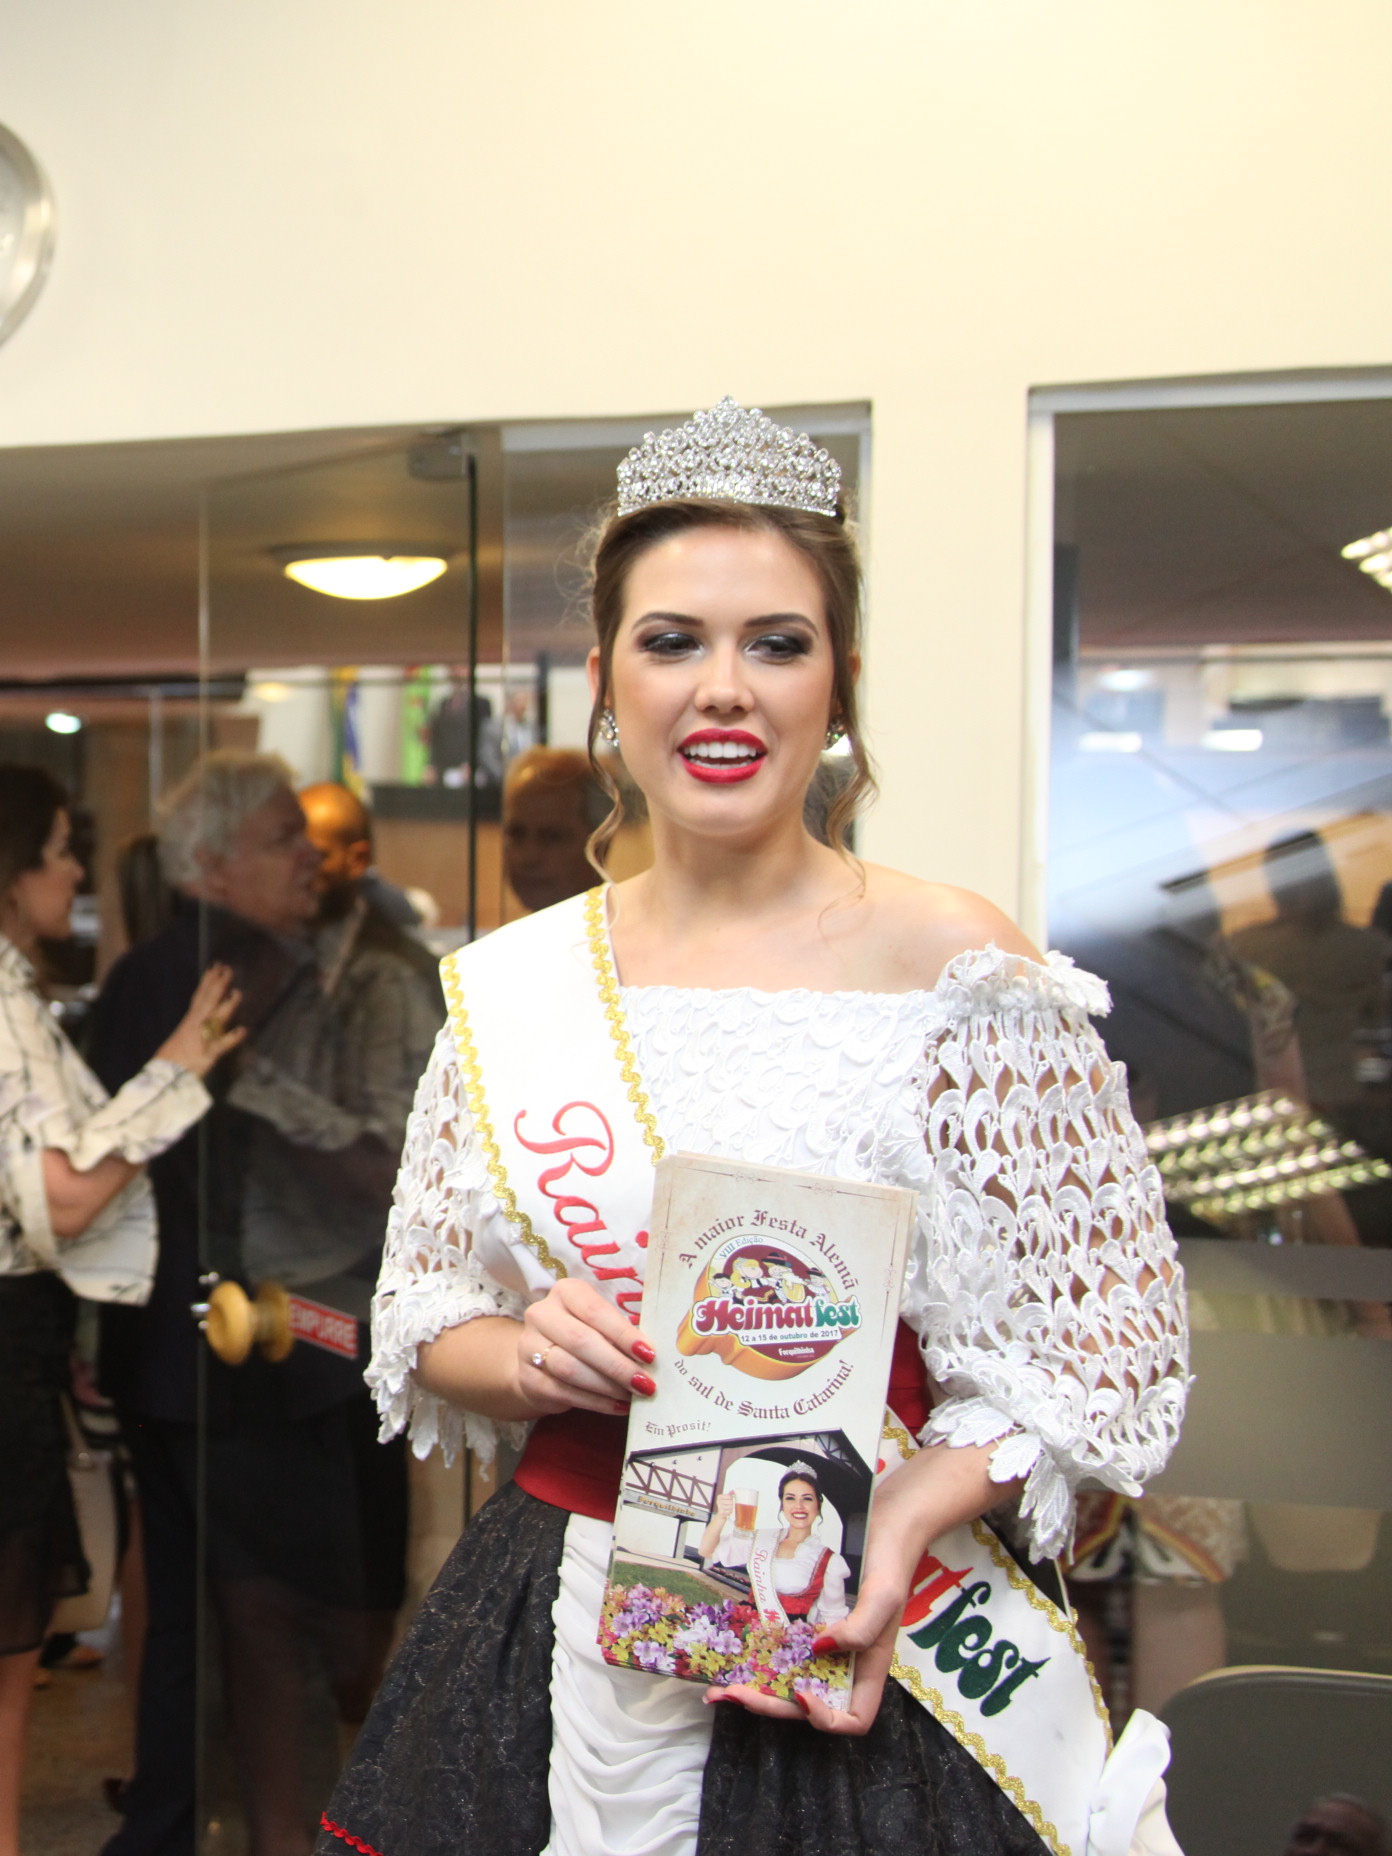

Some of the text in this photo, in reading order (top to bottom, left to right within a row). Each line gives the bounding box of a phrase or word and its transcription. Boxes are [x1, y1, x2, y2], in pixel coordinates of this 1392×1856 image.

[678, 1209, 859, 1291] A maior Festa Alemã
[719, 1235, 764, 1258] VIII Edição
[695, 1298, 861, 1332] Heimatfest
[780, 1332, 808, 1340] outubro
[810, 1331, 819, 1339] de
[821, 1329, 839, 1337] 2017
[674, 1359, 854, 1420] do sul de Santa Catarina!
[645, 1419, 711, 1438] Ein Prosit!
